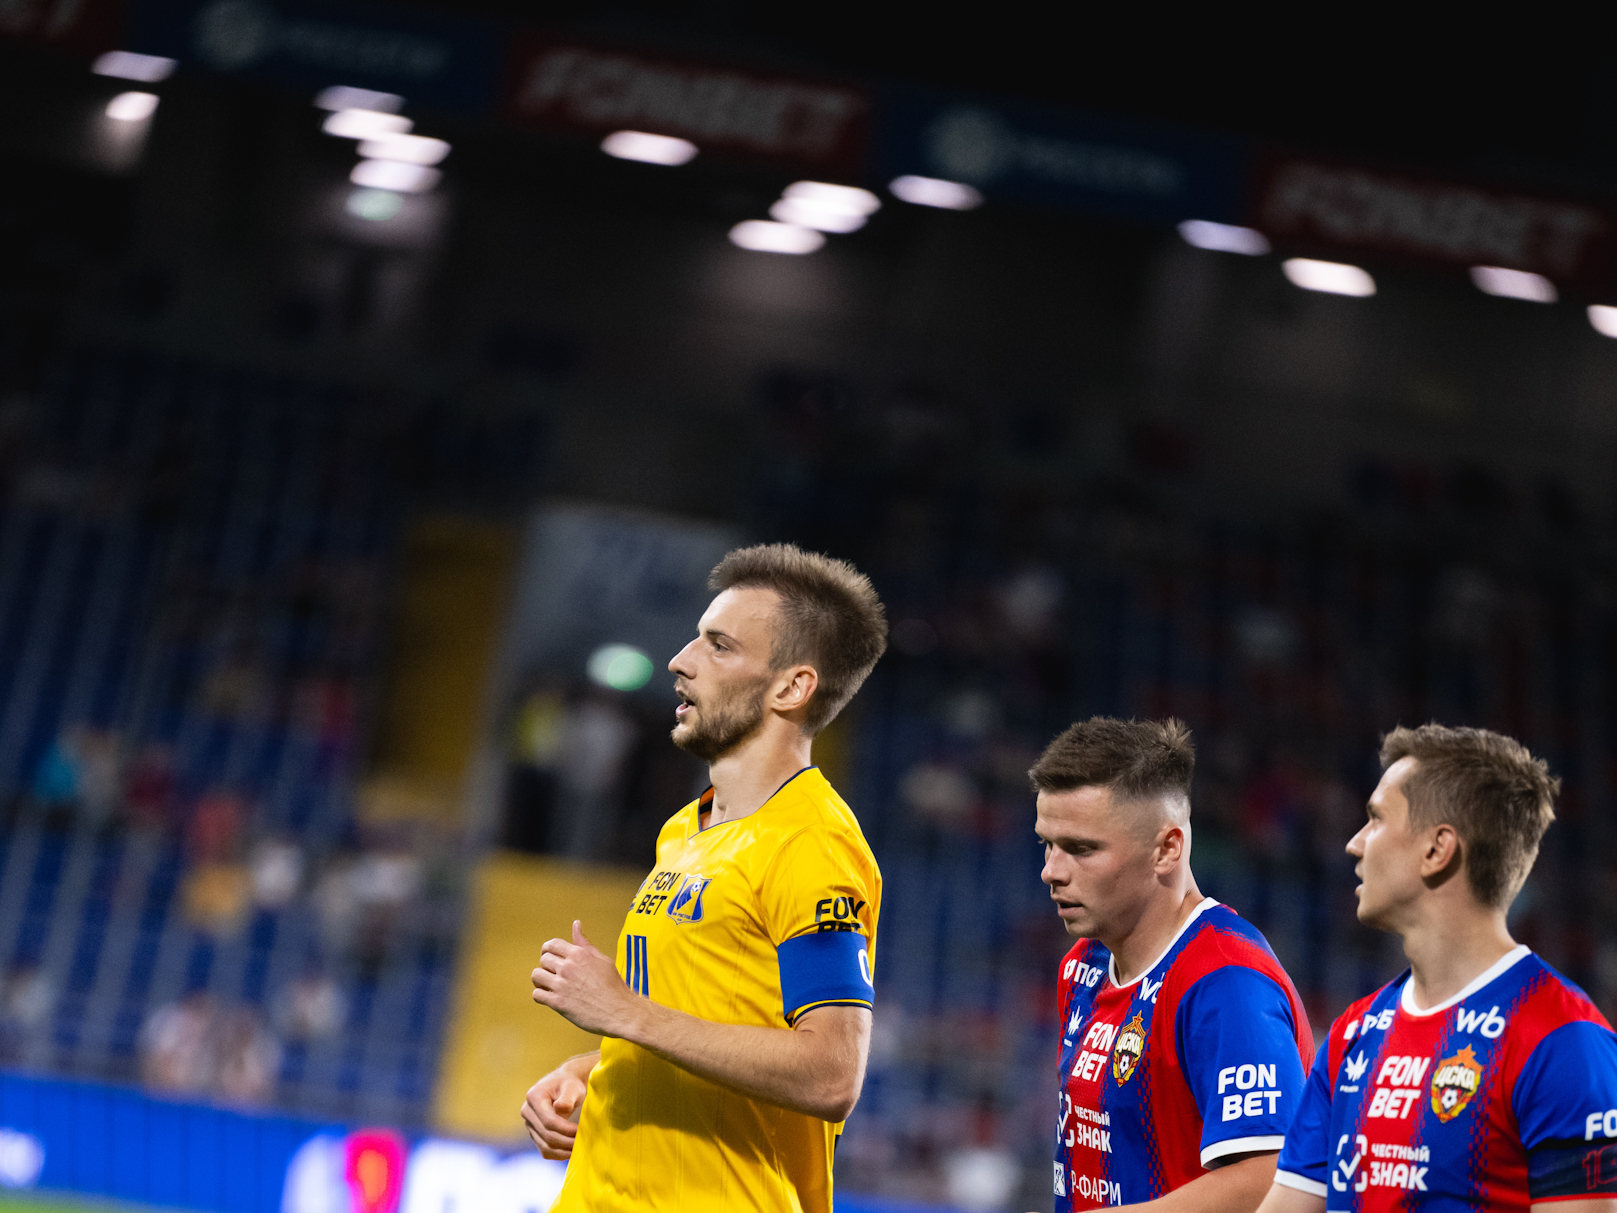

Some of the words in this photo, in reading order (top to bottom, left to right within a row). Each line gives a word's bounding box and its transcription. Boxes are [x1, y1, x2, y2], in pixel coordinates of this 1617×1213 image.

[648, 871, 681, 891] FON
[636, 894, 668, 915] BET
[1083, 1021, 1119, 1052] FON
[1117, 1033, 1141, 1054] ЦСКА
[1072, 1050, 1108, 1082] BET
[1218, 1064, 1276, 1094] FON
[1376, 1056, 1430, 1087] FON
[1435, 1066, 1475, 1090] ЦСКА
[1074, 1105, 1110, 1126] ЧЕСТНЫЙ
[1222, 1090, 1282, 1122] BET
[1367, 1088, 1422, 1120] BET
[1077, 1122, 1112, 1153] ЗНАК
[1371, 1143, 1430, 1163] ЧЕСТНЫЙ
[1071, 1170, 1122, 1206] Р-ФАРМ
[1370, 1161, 1429, 1191] ЗНАК
